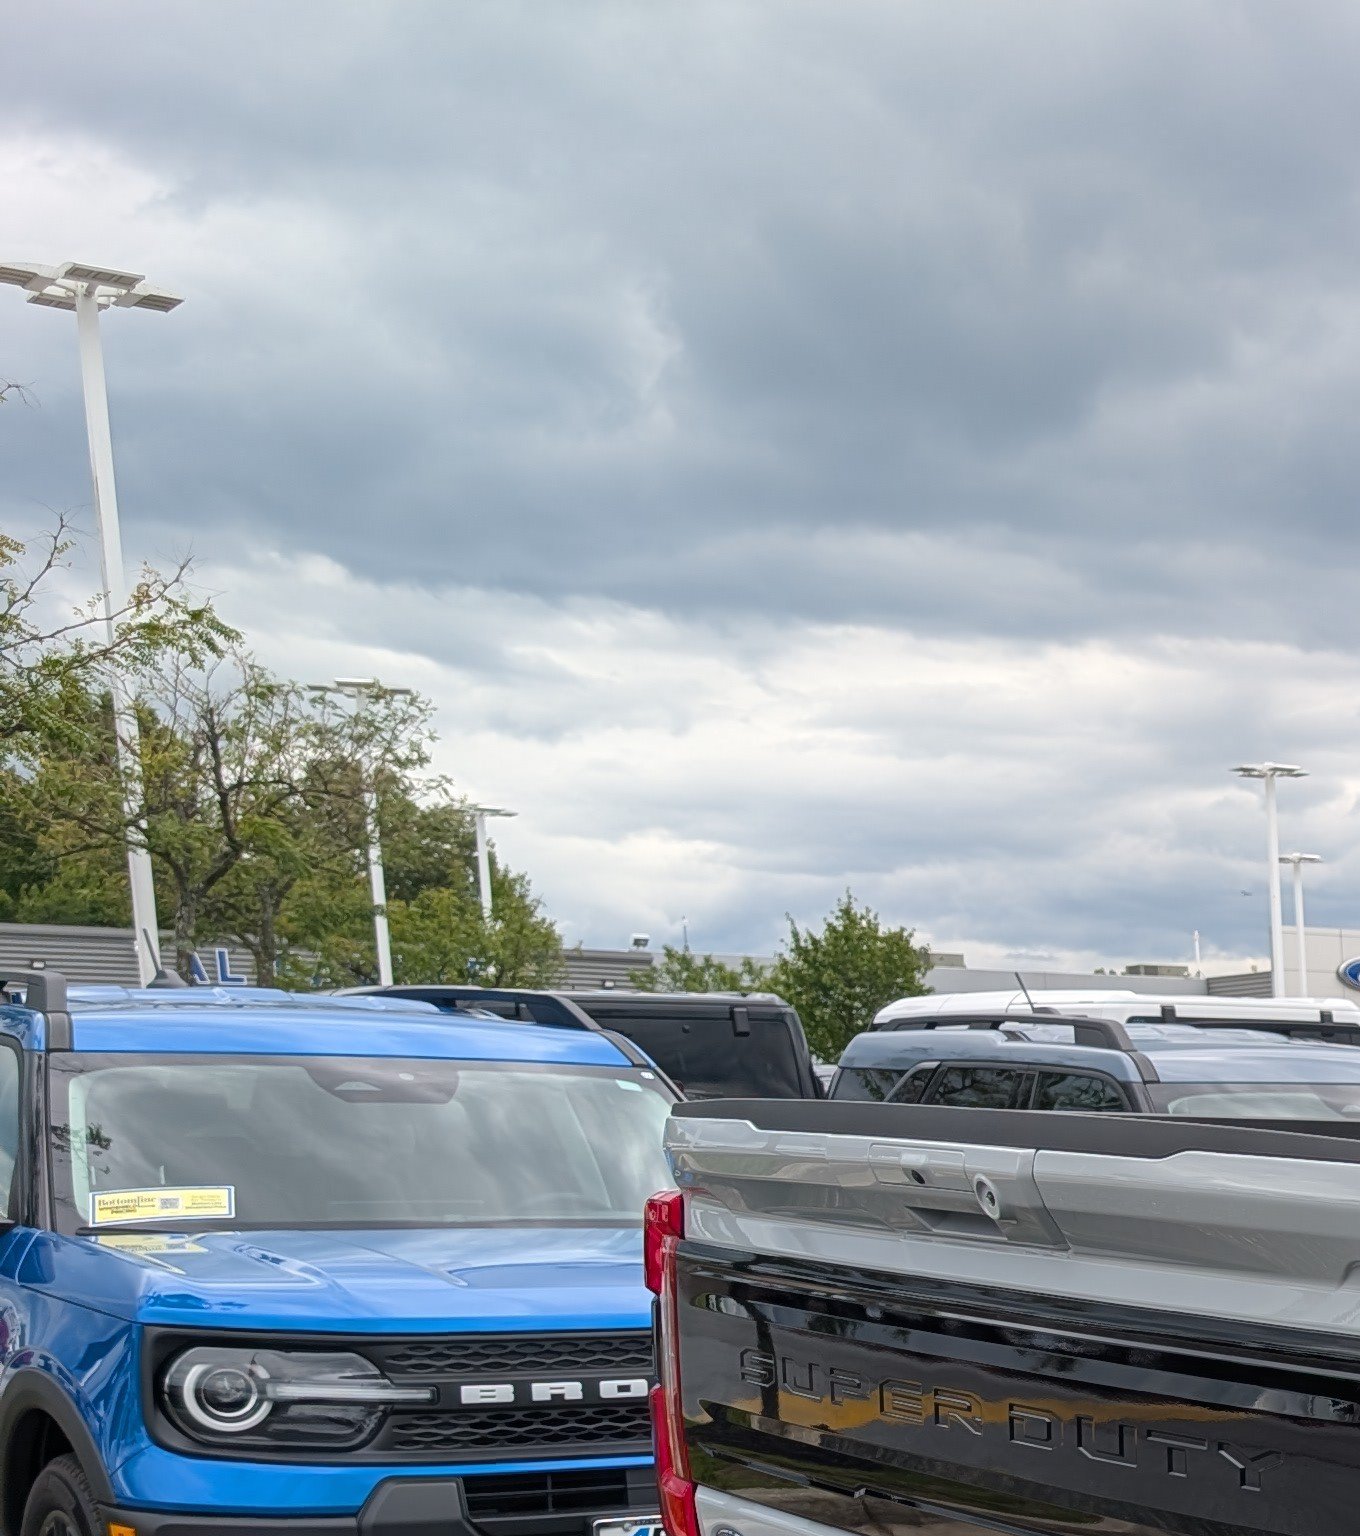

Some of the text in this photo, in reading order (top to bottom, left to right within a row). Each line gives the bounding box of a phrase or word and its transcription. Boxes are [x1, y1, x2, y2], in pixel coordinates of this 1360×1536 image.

[460, 1378, 649, 1405] BRO
[739, 1346, 1287, 1492] SUPER DUTY
